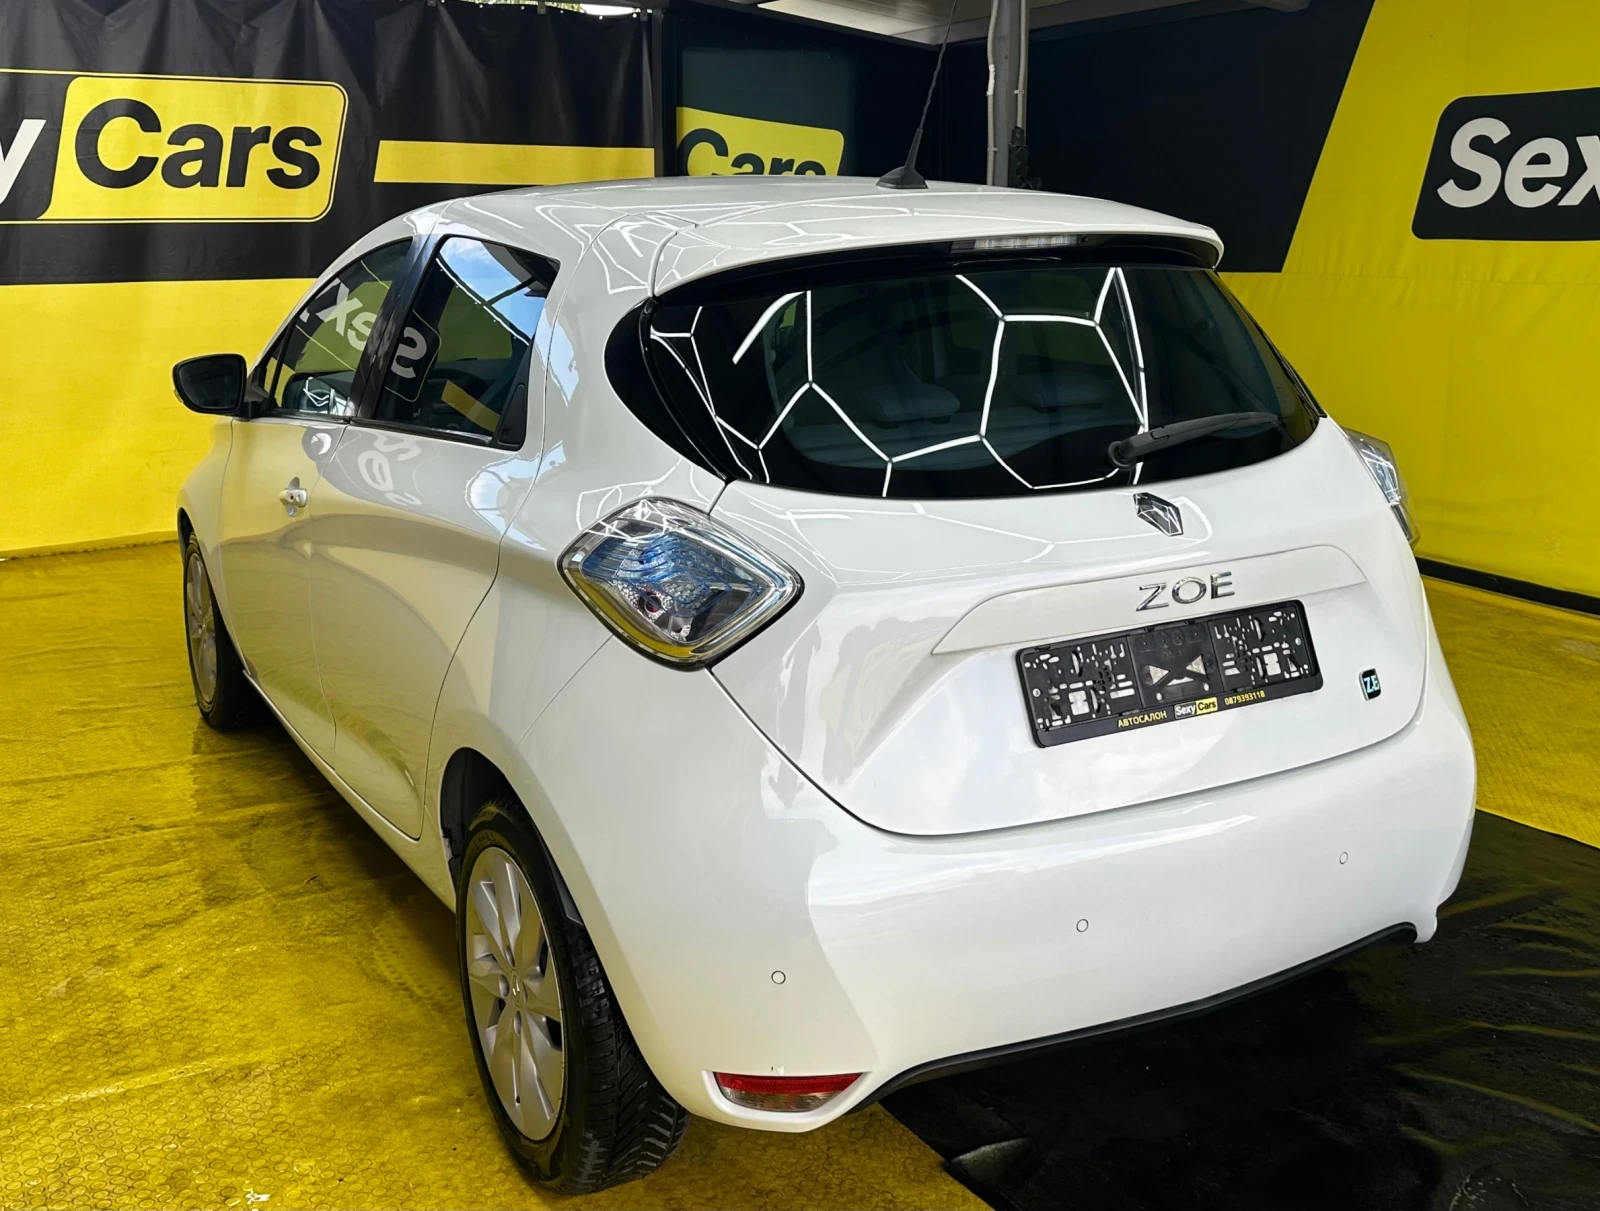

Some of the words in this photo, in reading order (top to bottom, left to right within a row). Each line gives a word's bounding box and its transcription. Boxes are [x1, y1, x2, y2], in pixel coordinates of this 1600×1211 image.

[75, 98, 321, 189] Cars
[1136, 571, 1235, 612] ZOE
[1118, 711, 1167, 728] АВТОСАЛОН
[1175, 704, 1196, 717] Sexy
[1197, 700, 1217, 711] Cars
[1224, 690, 1265, 706] 0879393118
